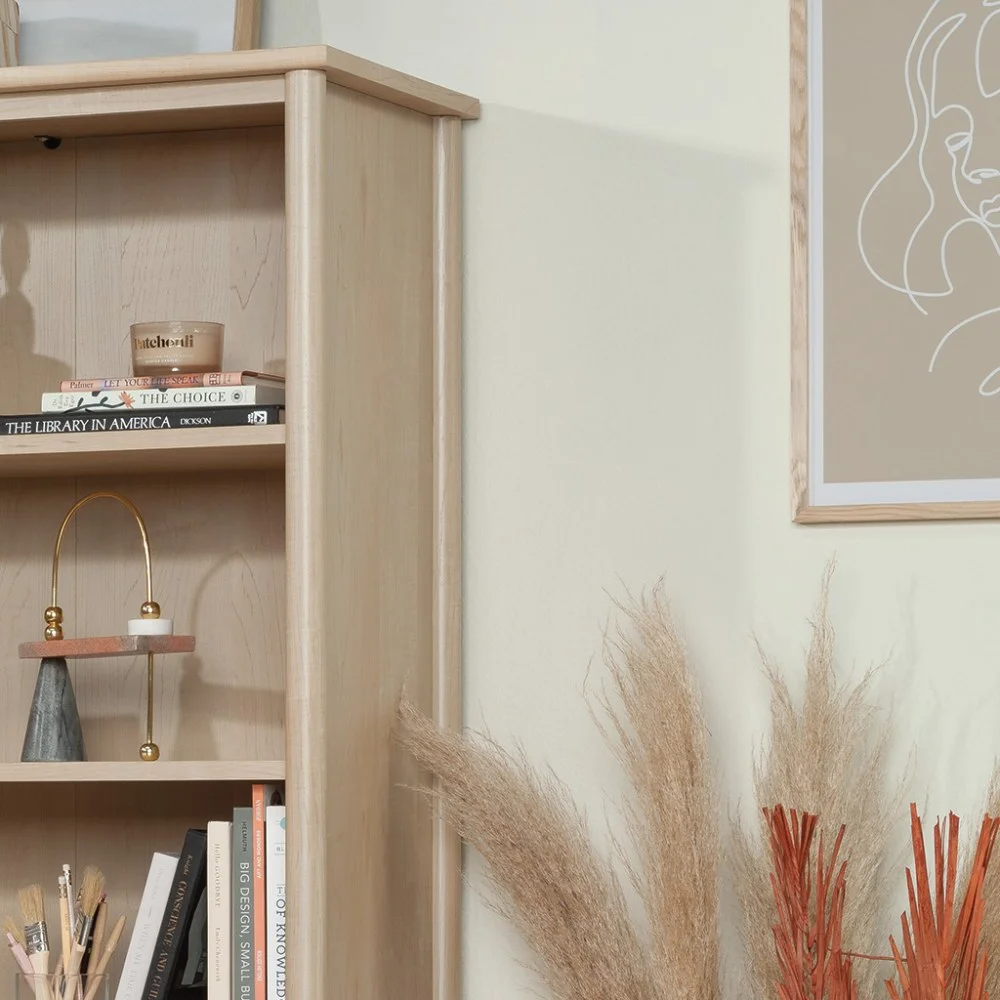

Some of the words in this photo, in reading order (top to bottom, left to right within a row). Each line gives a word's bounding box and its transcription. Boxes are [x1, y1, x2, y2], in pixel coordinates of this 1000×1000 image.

[69, 381, 94, 389] Palmer
[103, 380, 120, 388] LET
[124, 378, 149, 387] YOUR
[150, 376, 170, 385] LIFE
[170, 375, 199, 385] SPEAK
[140, 393, 169, 405] THE
[173, 391, 226, 403] CHOICE
[5, 422, 32, 435] THE
[35, 418, 90, 433] LIBRARY
[91, 417, 106, 431] IN
[108, 416, 171, 431] AMERICA
[180, 417, 212, 425] DICKSON
[239, 862, 250, 883] BIG
[162, 880, 188, 949] CONSCIENCE
[239, 887, 251, 938] DESIGN,
[275, 898, 286, 918] OF
[157, 950, 169, 973] AND
[240, 941, 251, 981] SMALL
